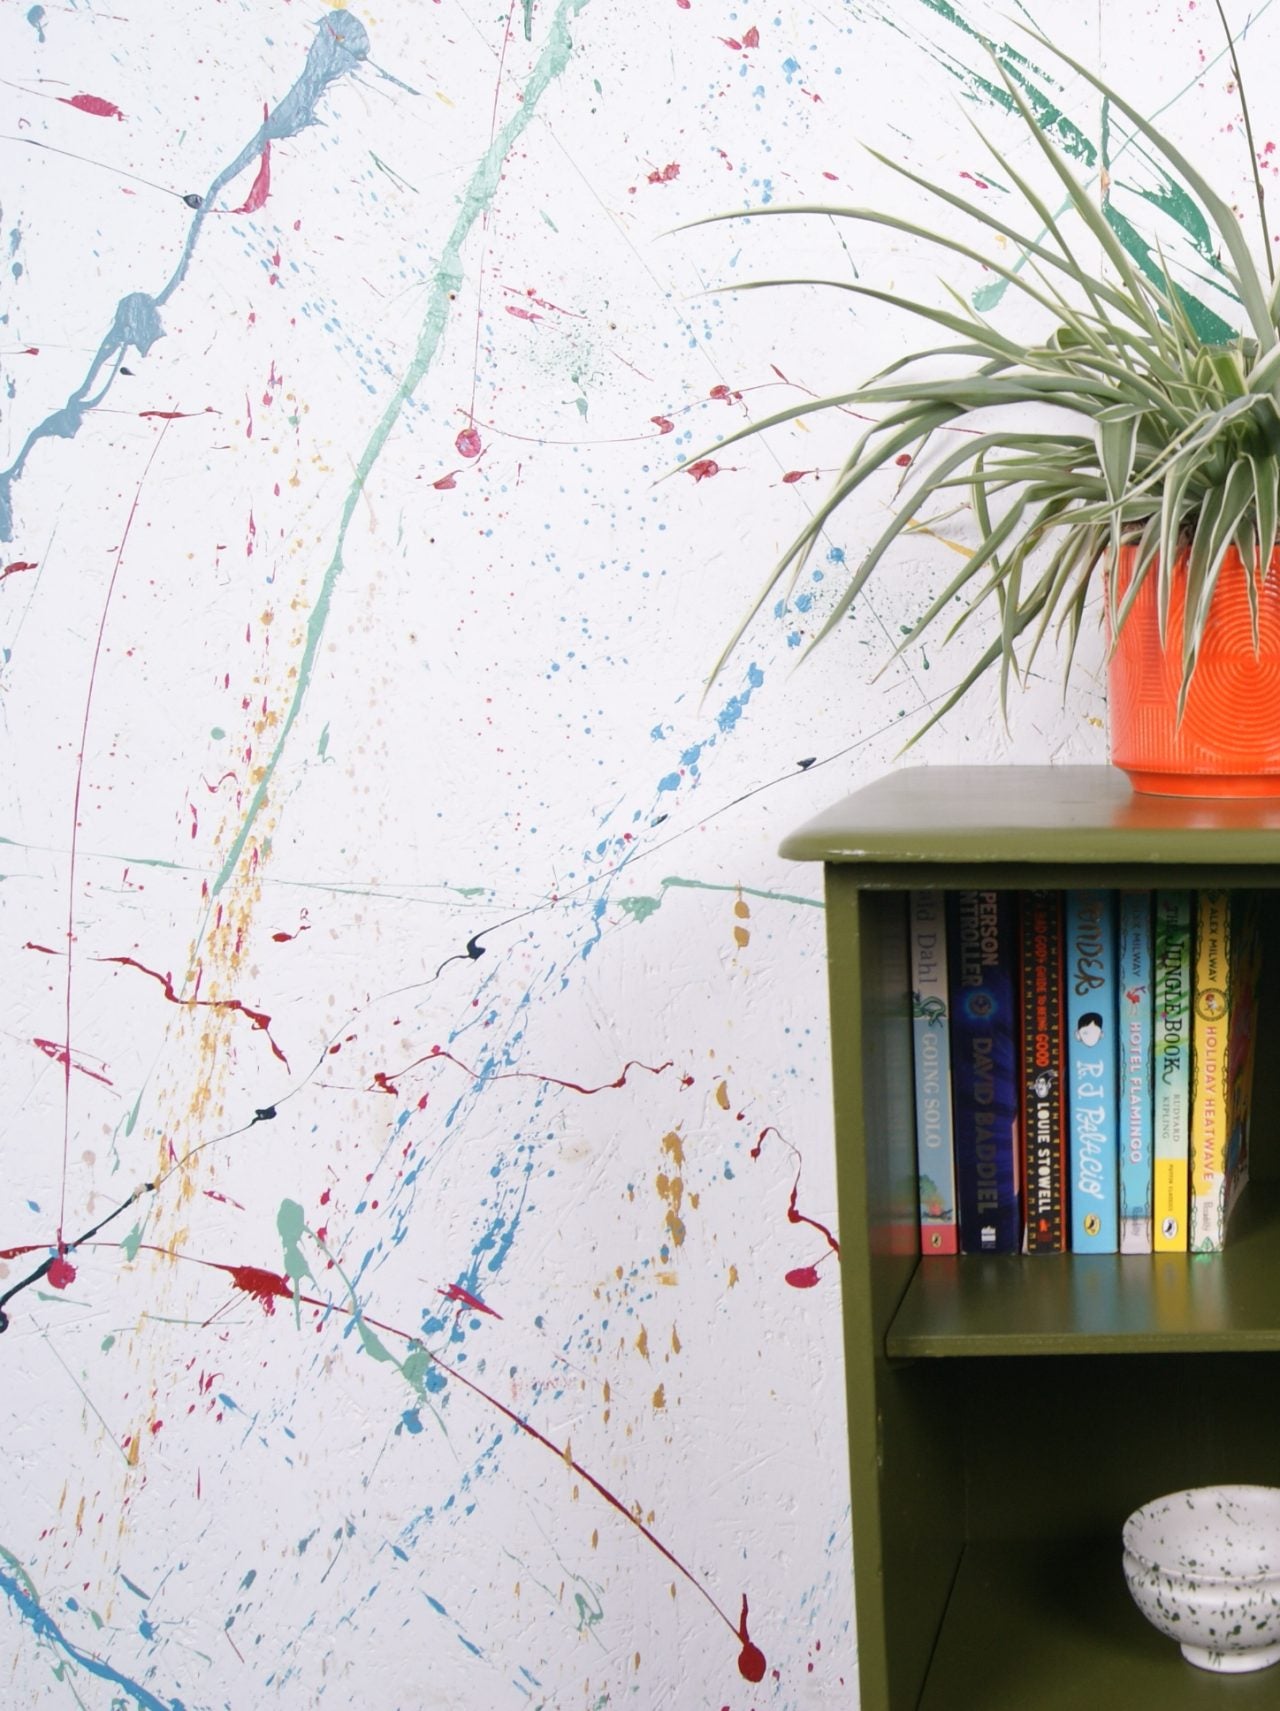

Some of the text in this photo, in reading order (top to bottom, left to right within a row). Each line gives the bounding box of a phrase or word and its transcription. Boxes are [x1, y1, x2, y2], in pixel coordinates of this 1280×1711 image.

[917, 933, 938, 984] Dahl
[980, 891, 999, 966] PERSON
[1132, 933, 1141, 977] MILWAY
[1208, 908, 1218, 983] ALEX MILWAY
[1036, 965, 1049, 992] GUIDE
[1162, 905, 1184, 1086] THE JUNGLE BOOK
[1035, 1033, 1050, 1067] GOOD
[1037, 1006, 1048, 1031] BEING
[922, 1033, 942, 1149] GOING SOLO
[972, 1037, 995, 1105] DAVID
[1076, 1060, 1104, 1081] R.
[1077, 1083, 1104, 1100] J.
[1129, 1022, 1142, 1164] HOTEL FLAMINGO
[1203, 1026, 1217, 1181] HOLIDAY HEATWAVE
[1163, 1096, 1171, 1139] KIPLING
[974, 1112, 998, 1214] BADDIEL
[1036, 1101, 1052, 1213] LOUIE STOWELL
